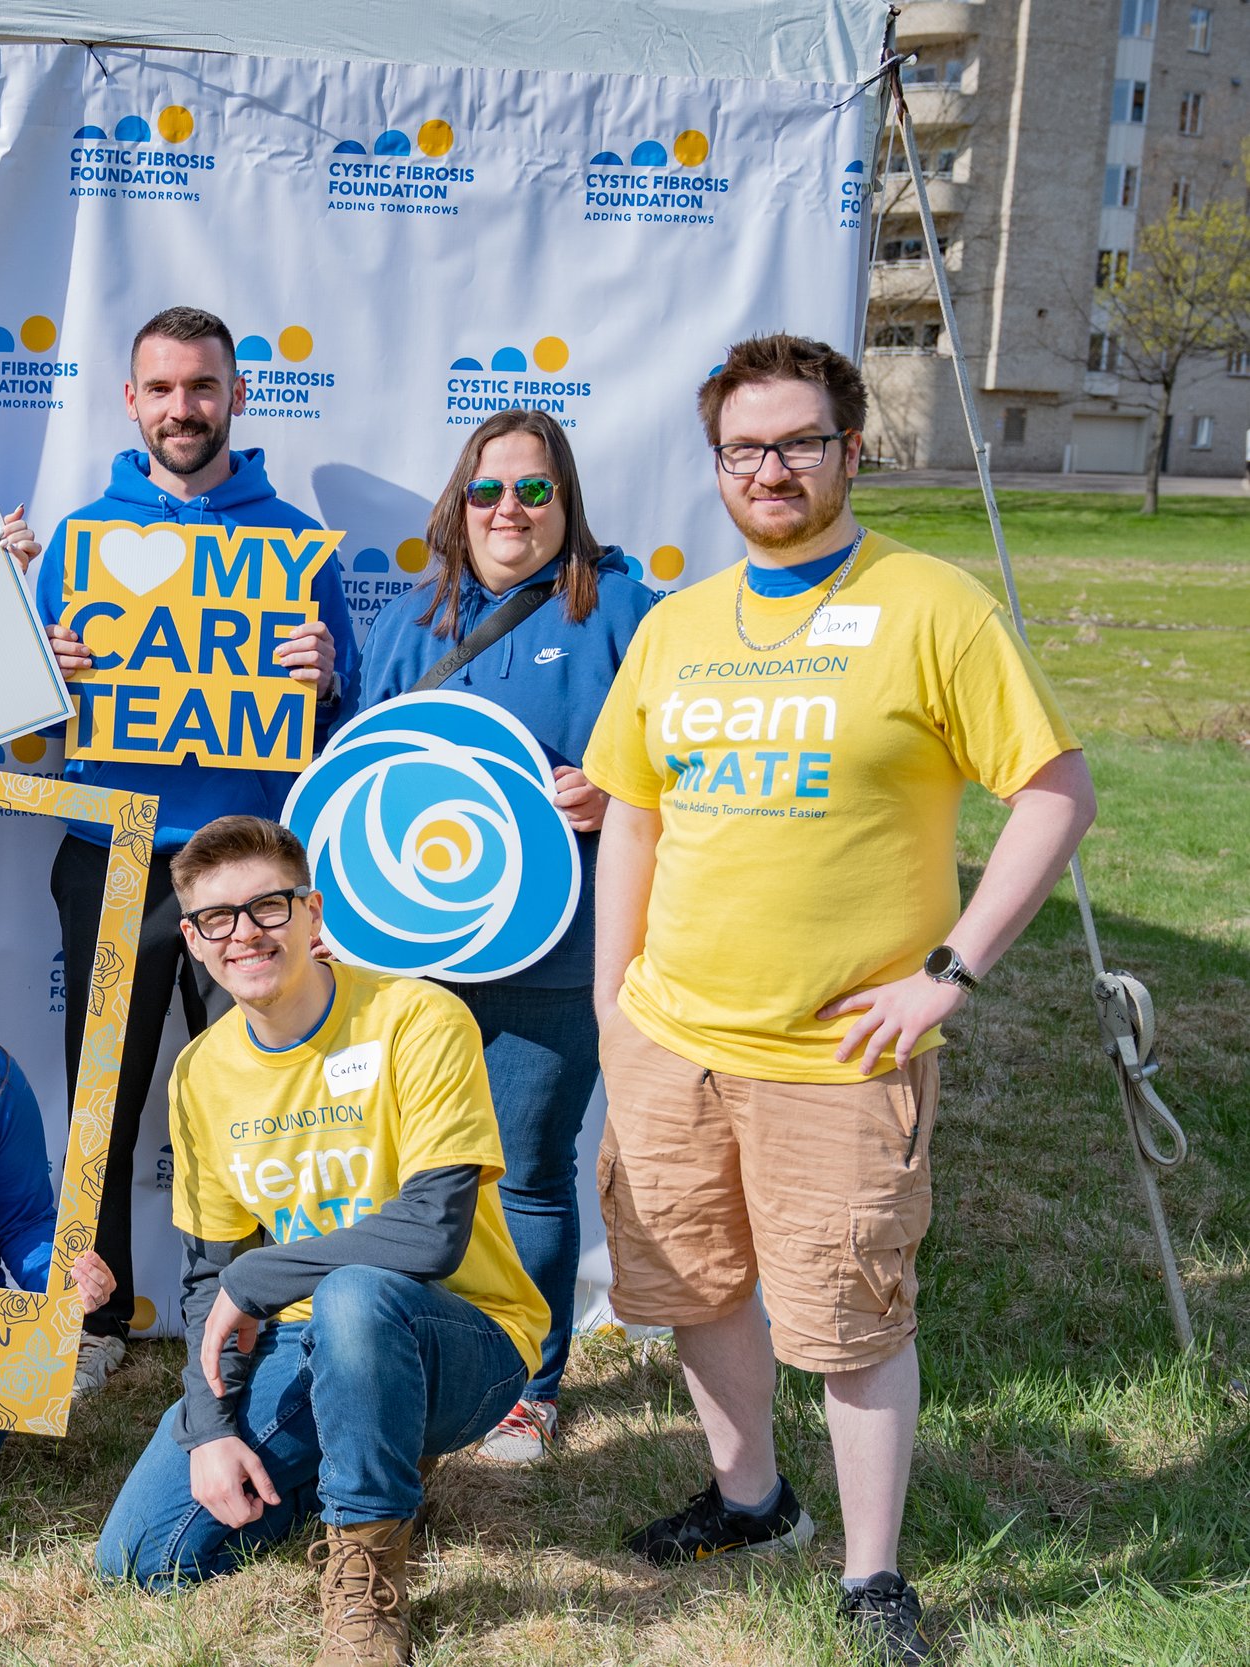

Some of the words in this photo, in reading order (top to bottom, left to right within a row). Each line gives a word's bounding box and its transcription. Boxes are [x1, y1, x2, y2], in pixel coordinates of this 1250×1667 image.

[69, 146, 132, 165] CYSTIC
[137, 152, 214, 170] FIBROSIS
[70, 165, 188, 185] FOUNDATION
[329, 162, 391, 178] CYSTIC
[396, 166, 474, 182] FIBROSIS
[329, 181, 447, 199] FOUNDATION
[584, 174, 647, 189] CYSTIC
[654, 176, 728, 192] FIBROSIS
[69, 187, 117, 199] ADDING
[121, 189, 200, 202] TOMORROWS
[586, 192, 702, 208] FOUNDATION
[328, 201, 374, 211] ADDING
[381, 204, 458, 215] TOMORROWS
[584, 212, 631, 221] ADDING
[637, 214, 714, 224] TOMORROWS
[1, 362, 78, 377] FIBROSIS
[258, 371, 334, 387] FIBROSIS
[245, 388, 309, 403] DATION
[448, 379, 508, 394] CYSTIC
[514, 381, 590, 396] FIBROSIS
[447, 397, 564, 413] FOUNDATION
[447, 416, 485, 425] ADDIN
[192, 536, 323, 602] MY
[342, 580, 370, 594] TIC
[69, 601, 308, 678] CARE
[540, 647, 562, 659] NIKE
[679, 664, 703, 680] CF
[706, 656, 849, 677] FOUNDATION
[67, 682, 303, 760] TEAM
[661, 691, 836, 744] team
[690, 802, 718, 816] Adding
[722, 804, 785, 817] Tomorrows
[790, 807, 828, 818] Easier
[331, 1062, 368, 1077] Carter
[230, 1122, 249, 1139] CF
[229, 1146, 373, 1203] team
